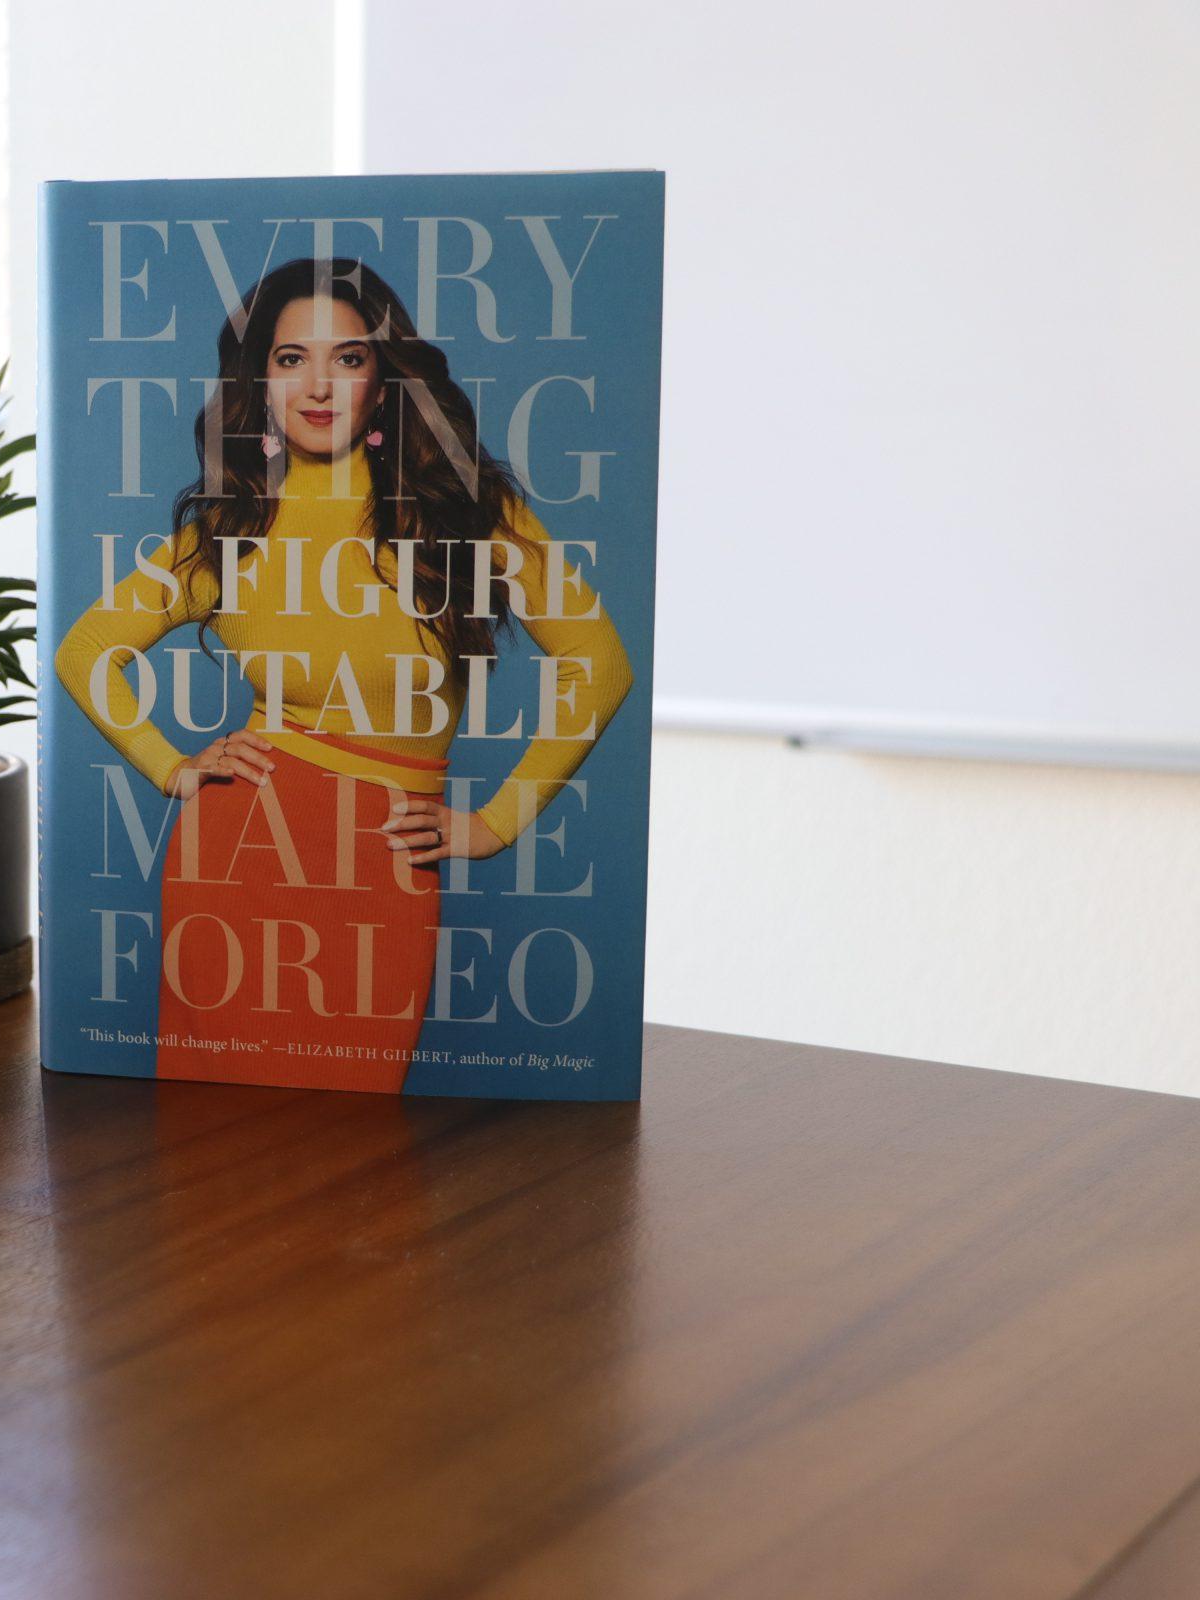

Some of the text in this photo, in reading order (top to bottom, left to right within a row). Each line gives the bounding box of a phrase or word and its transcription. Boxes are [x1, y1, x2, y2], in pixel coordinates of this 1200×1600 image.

[87, 214, 620, 343] EVERY
[86, 375, 618, 504] THING
[92, 532, 601, 622] IS FIGURE
[88, 644, 598, 742] OUTABLE
[89, 763, 594, 898] MARIE
[89, 908, 596, 1028] FORLEO
[117, 1030, 151, 1045] book
[153, 1034, 179, 1048] will
[181, 1034, 228, 1053] change
[382, 1049, 457, 1066] GILBERT,
[460, 1052, 505, 1067] author
[509, 1052, 527, 1067] of
[527, 1054, 550, 1071] Big
[552, 1055, 595, 1071] Magic
